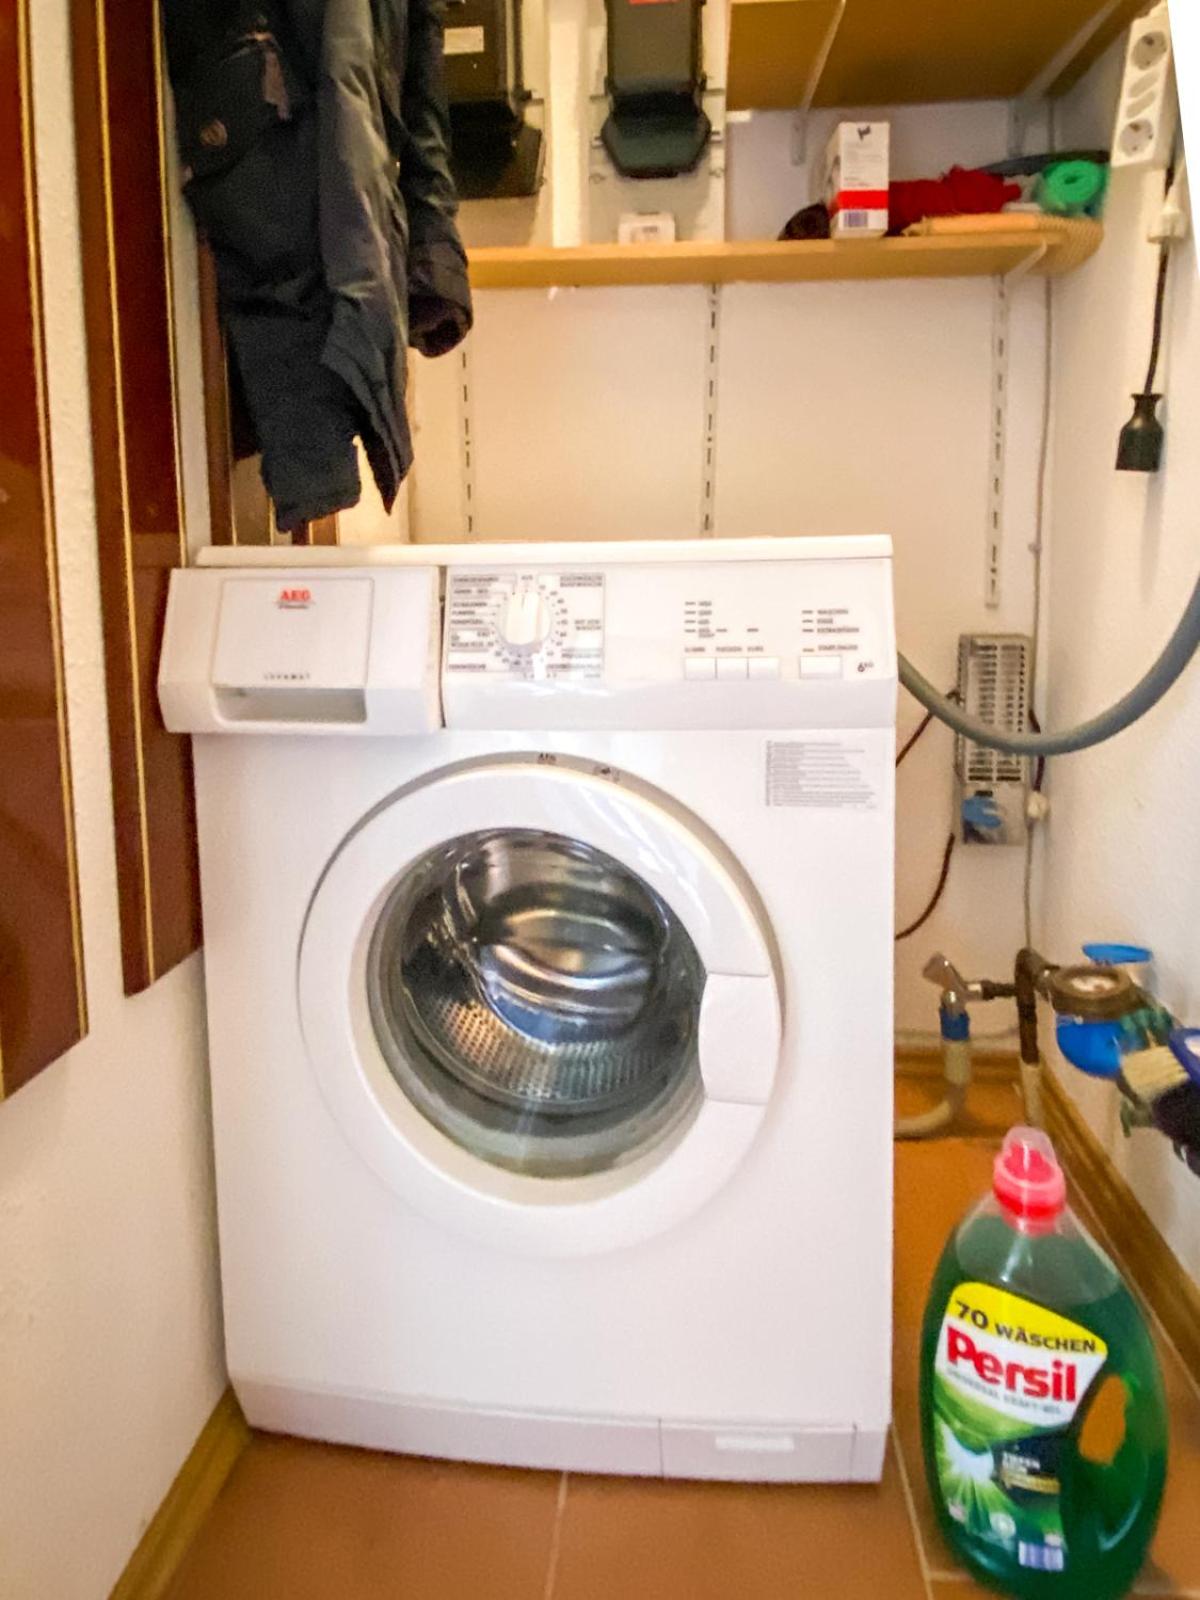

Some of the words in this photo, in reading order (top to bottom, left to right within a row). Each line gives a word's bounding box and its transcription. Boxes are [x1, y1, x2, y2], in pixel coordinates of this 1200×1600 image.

[280, 590, 311, 601] AEG
[957, 1301, 989, 1329] 70
[996, 1322, 1096, 1353] WÄSCHEN
[947, 1326, 1076, 1401] Persil
